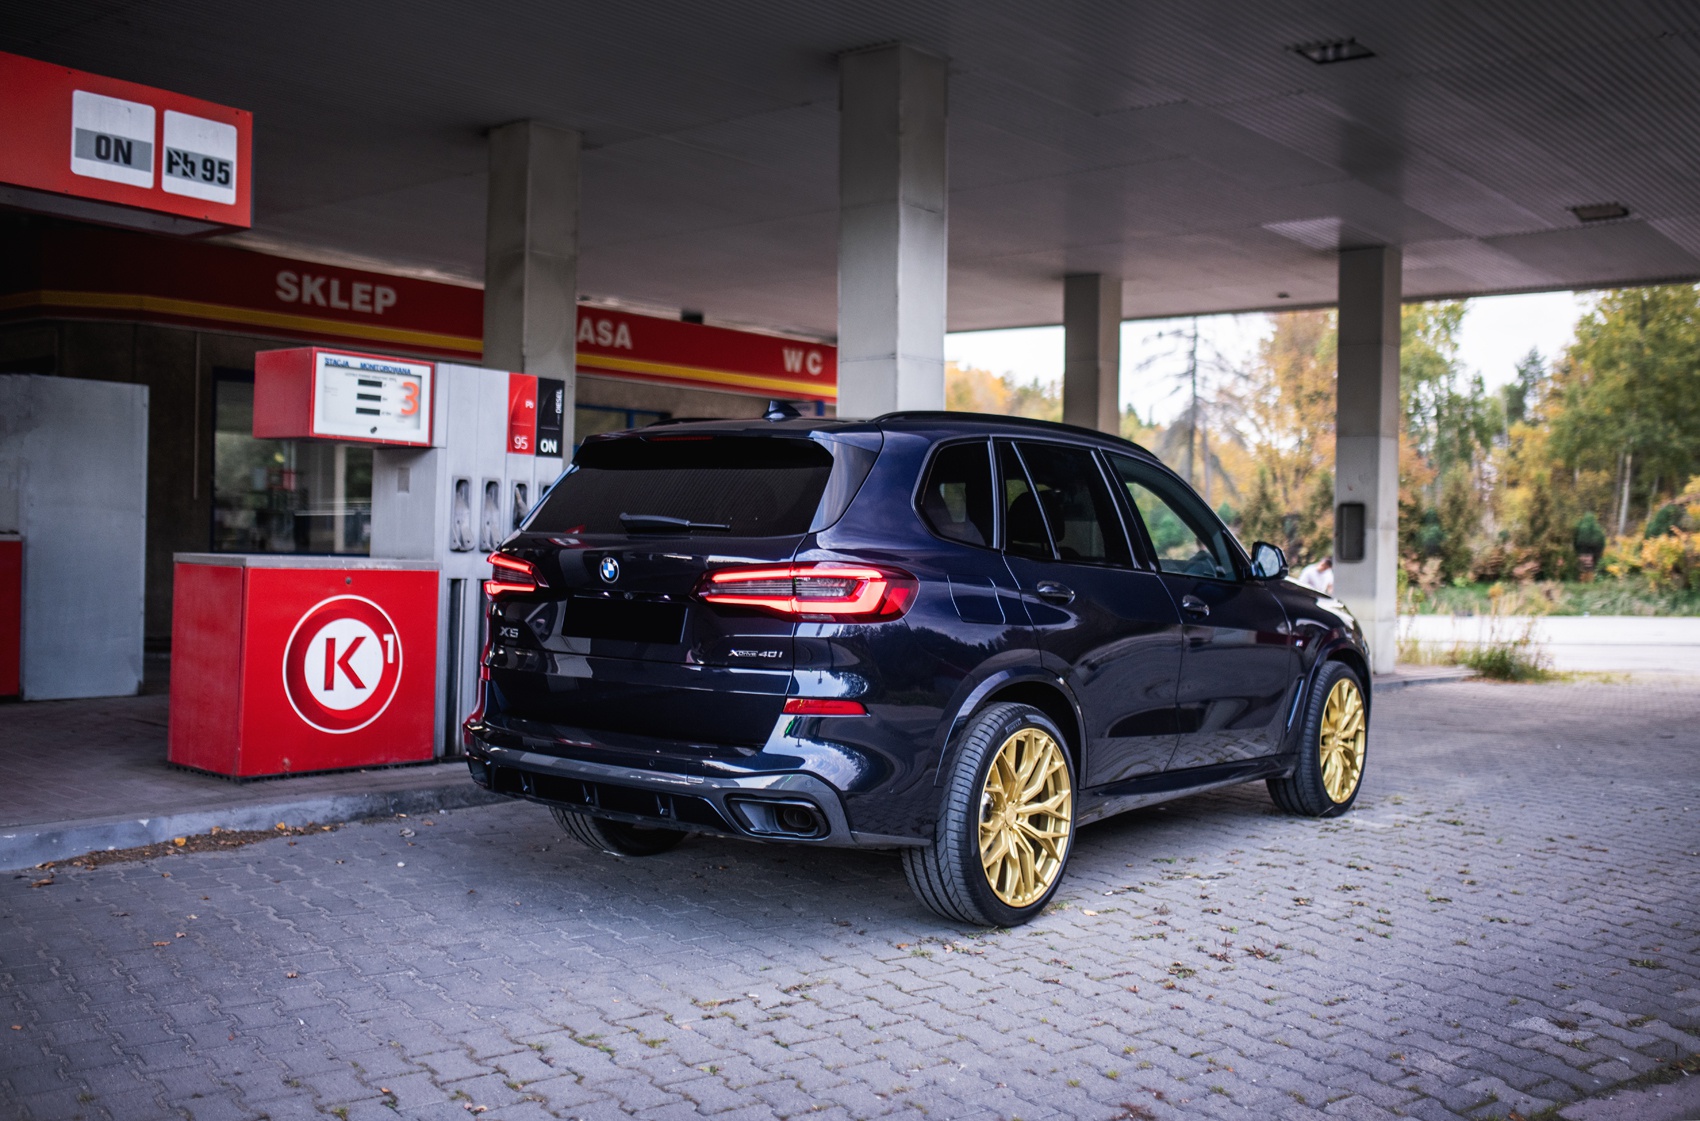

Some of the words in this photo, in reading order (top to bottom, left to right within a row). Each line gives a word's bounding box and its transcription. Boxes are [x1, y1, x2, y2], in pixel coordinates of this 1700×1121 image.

[95, 134, 132, 166] ON
[166, 149, 195, 177] Pb
[201, 157, 231, 185] 95
[275, 270, 397, 315] SKLEP
[578, 316, 633, 350] ASA
[324, 357, 350, 368] STACJA
[360, 362, 411, 375] MONITOROWANA
[782, 347, 823, 376] WC
[401, 381, 419, 416] 3
[514, 435, 528, 450] 95
[540, 439, 557, 453] ON
[500, 626, 518, 638] X5
